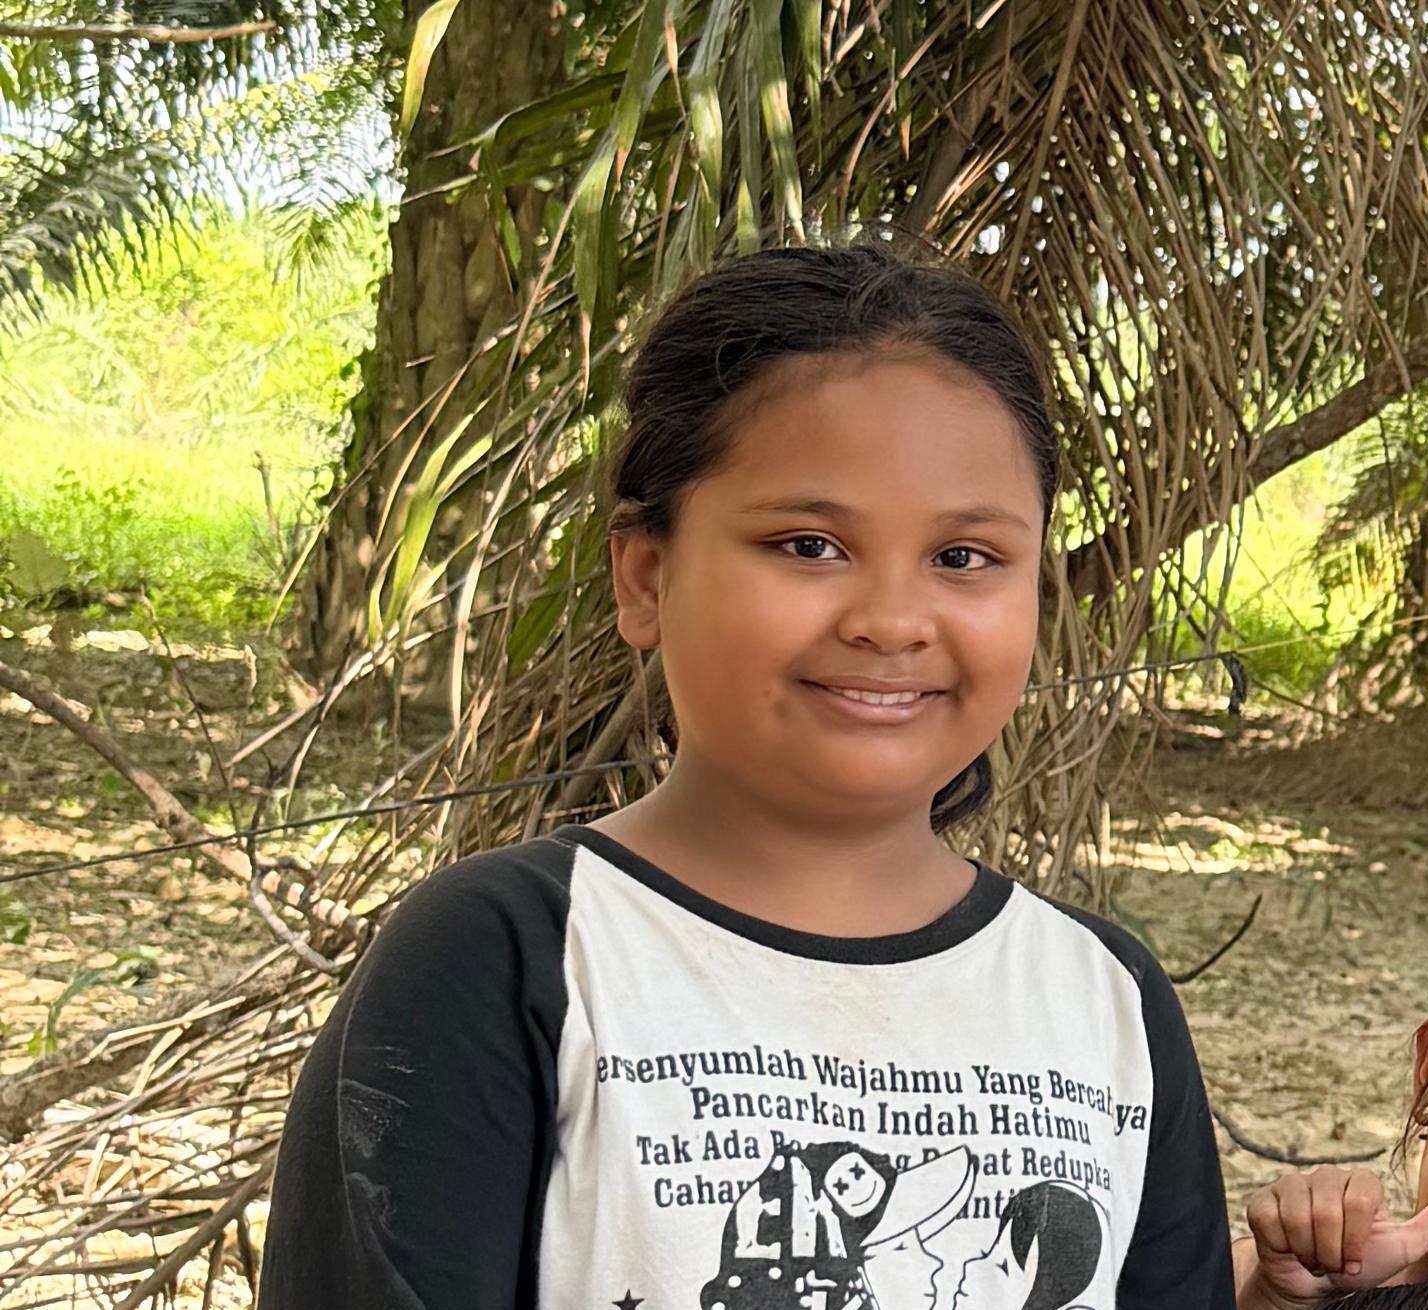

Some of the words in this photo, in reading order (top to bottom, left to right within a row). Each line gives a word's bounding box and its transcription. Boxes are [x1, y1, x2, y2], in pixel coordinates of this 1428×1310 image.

[597, 1045, 808, 1086] ersenyumlah
[811, 1053, 963, 1098] Wajahmu
[971, 1064, 1043, 1105] Yang
[690, 1086, 867, 1133] Pancarkan
[877, 1102, 979, 1136] Indah
[989, 1103, 1092, 1146] Hatimu
[636, 1134, 693, 1166] Tak
[702, 1129, 761, 1161] Ada
[1021, 1147, 1111, 1191] Redupka
